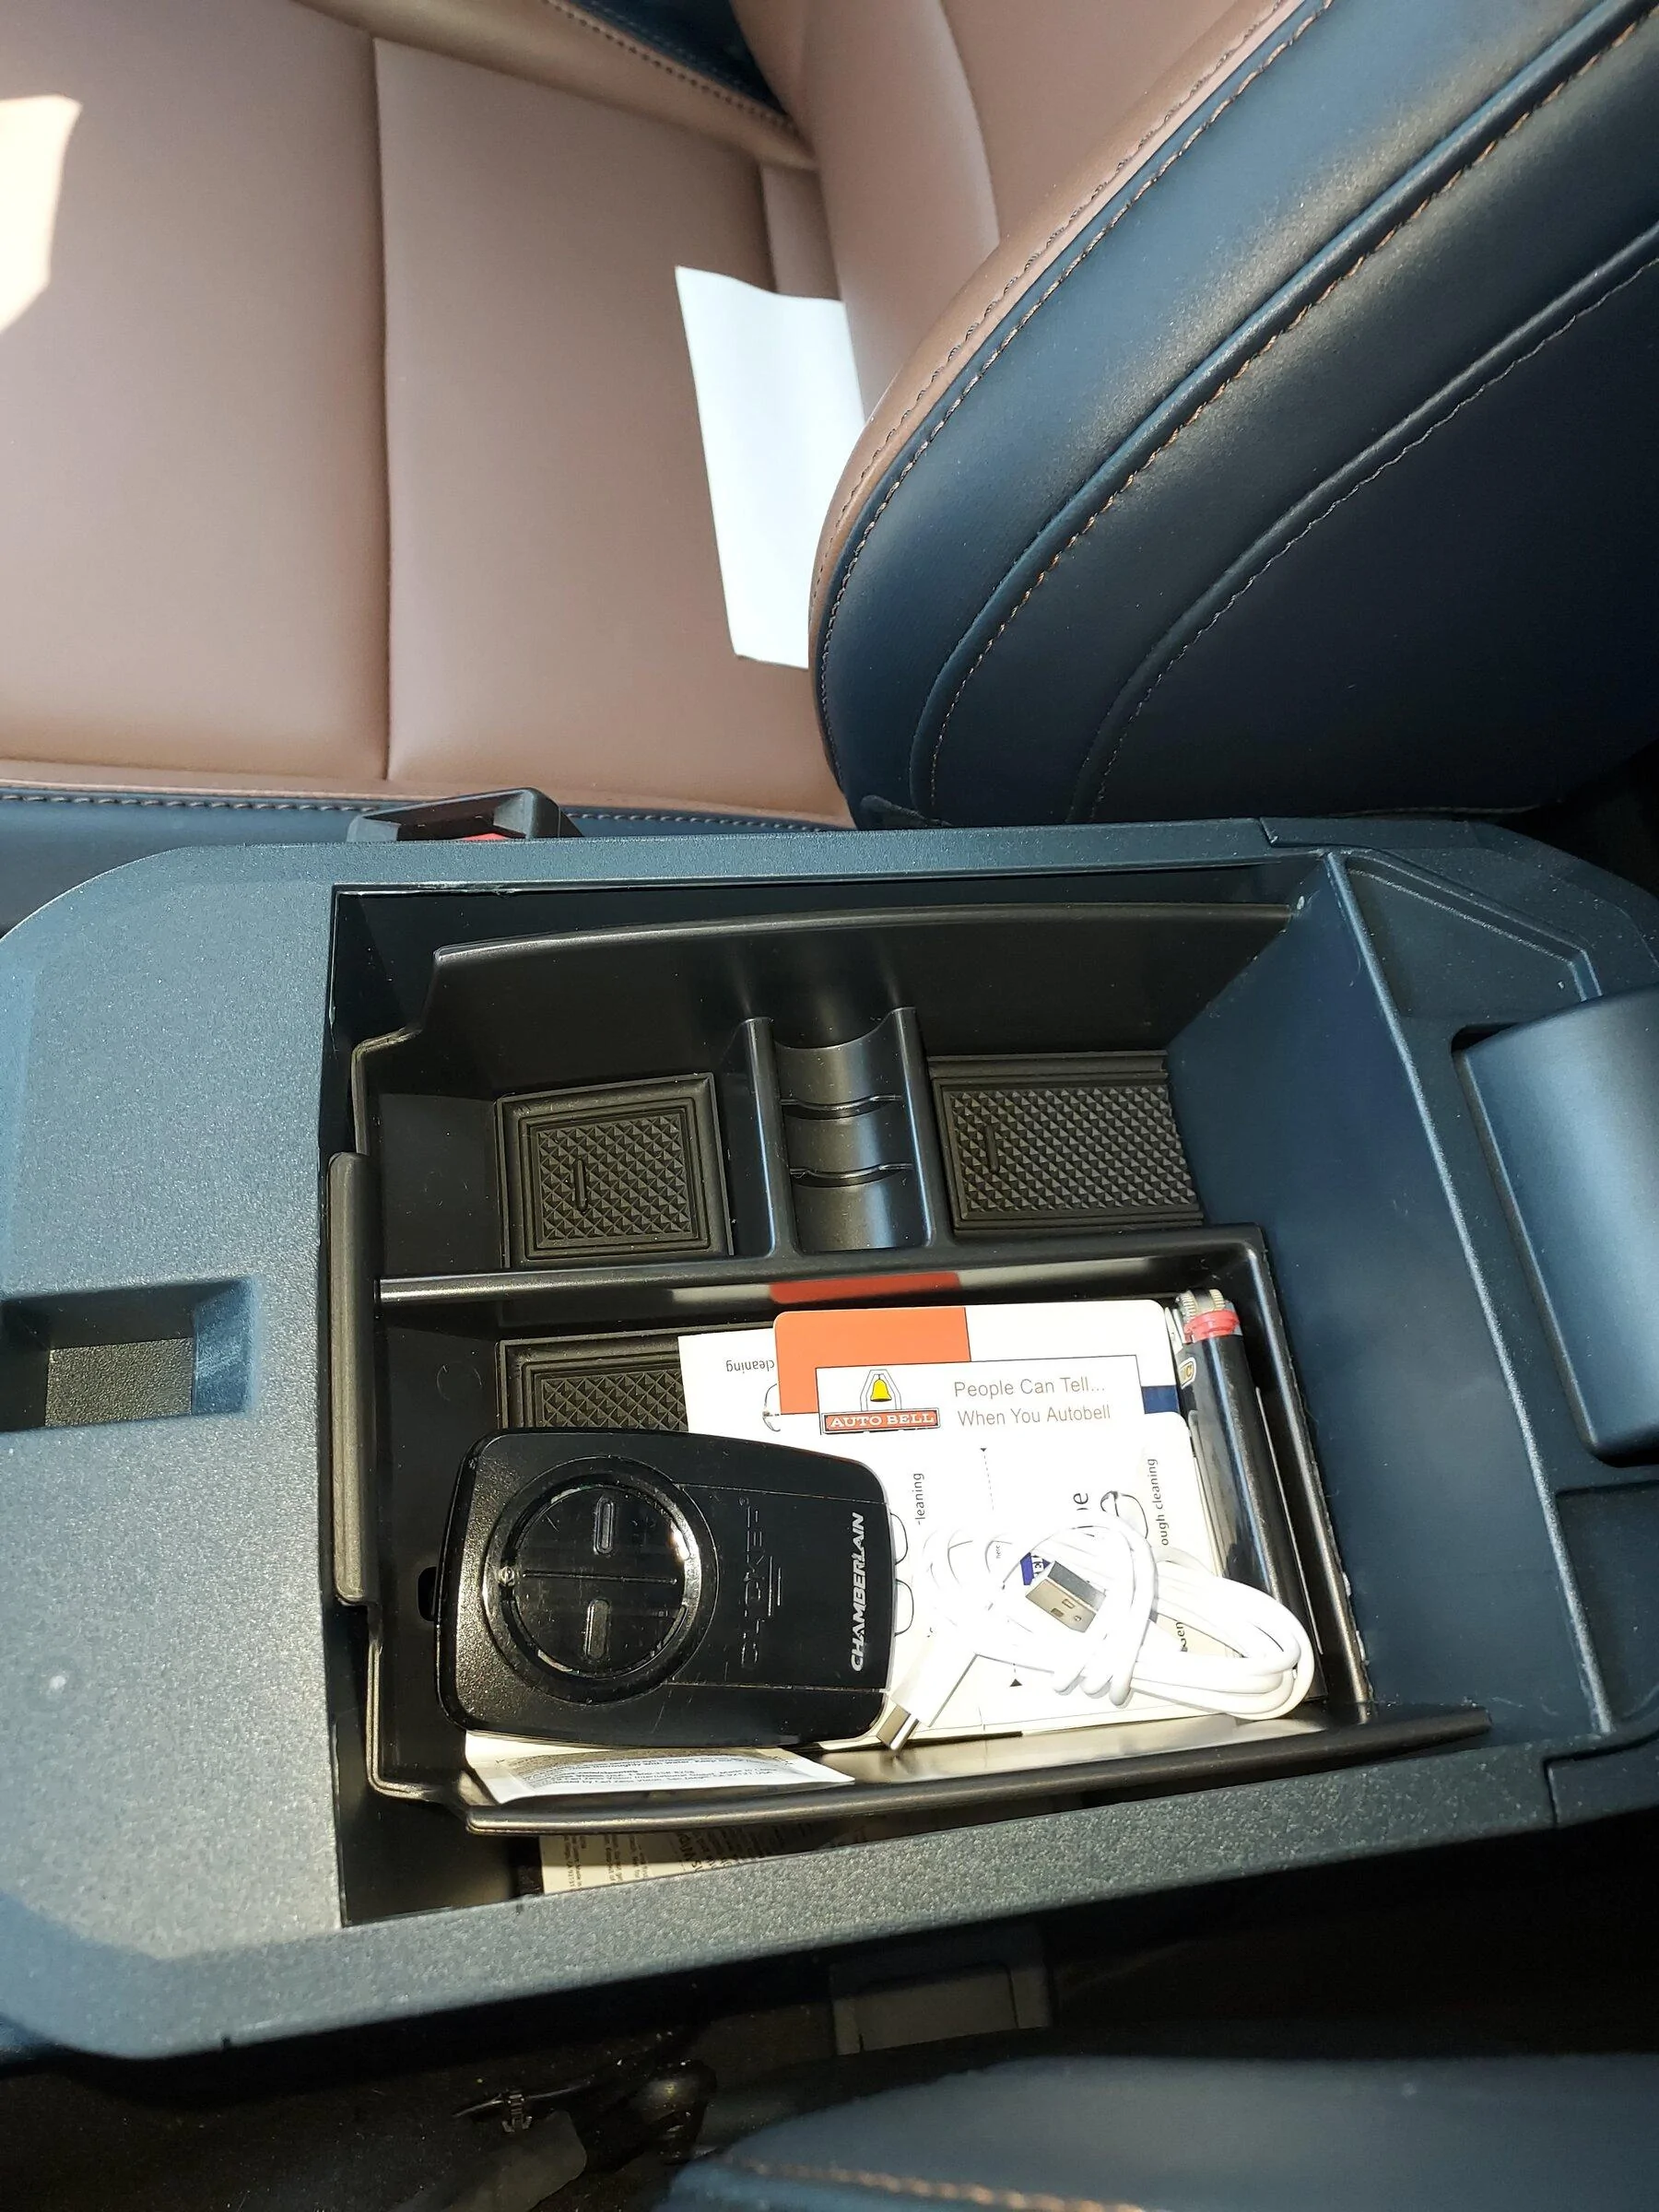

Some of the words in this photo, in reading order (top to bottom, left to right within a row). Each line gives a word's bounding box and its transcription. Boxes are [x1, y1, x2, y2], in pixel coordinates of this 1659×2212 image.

[725, 1359, 775, 1374] cleaning
[954, 1381, 1014, 1400] People
[1019, 1378, 1055, 1395] Can
[1060, 1376, 1105, 1394] Tell...
[829, 1414, 883, 1429] AUTO
[886, 1411, 935, 1426] BELL
[957, 1408, 1006, 1428] When
[1010, 1406, 1041, 1424] You
[1046, 1404, 1112, 1422] Autobell
[1147, 1457, 1165, 1511] cleaning
[912, 1473, 926, 1526] leaning
[1155, 1513, 1170, 1547] ough
[850, 1511, 867, 1673] CHAMBERLAIN
